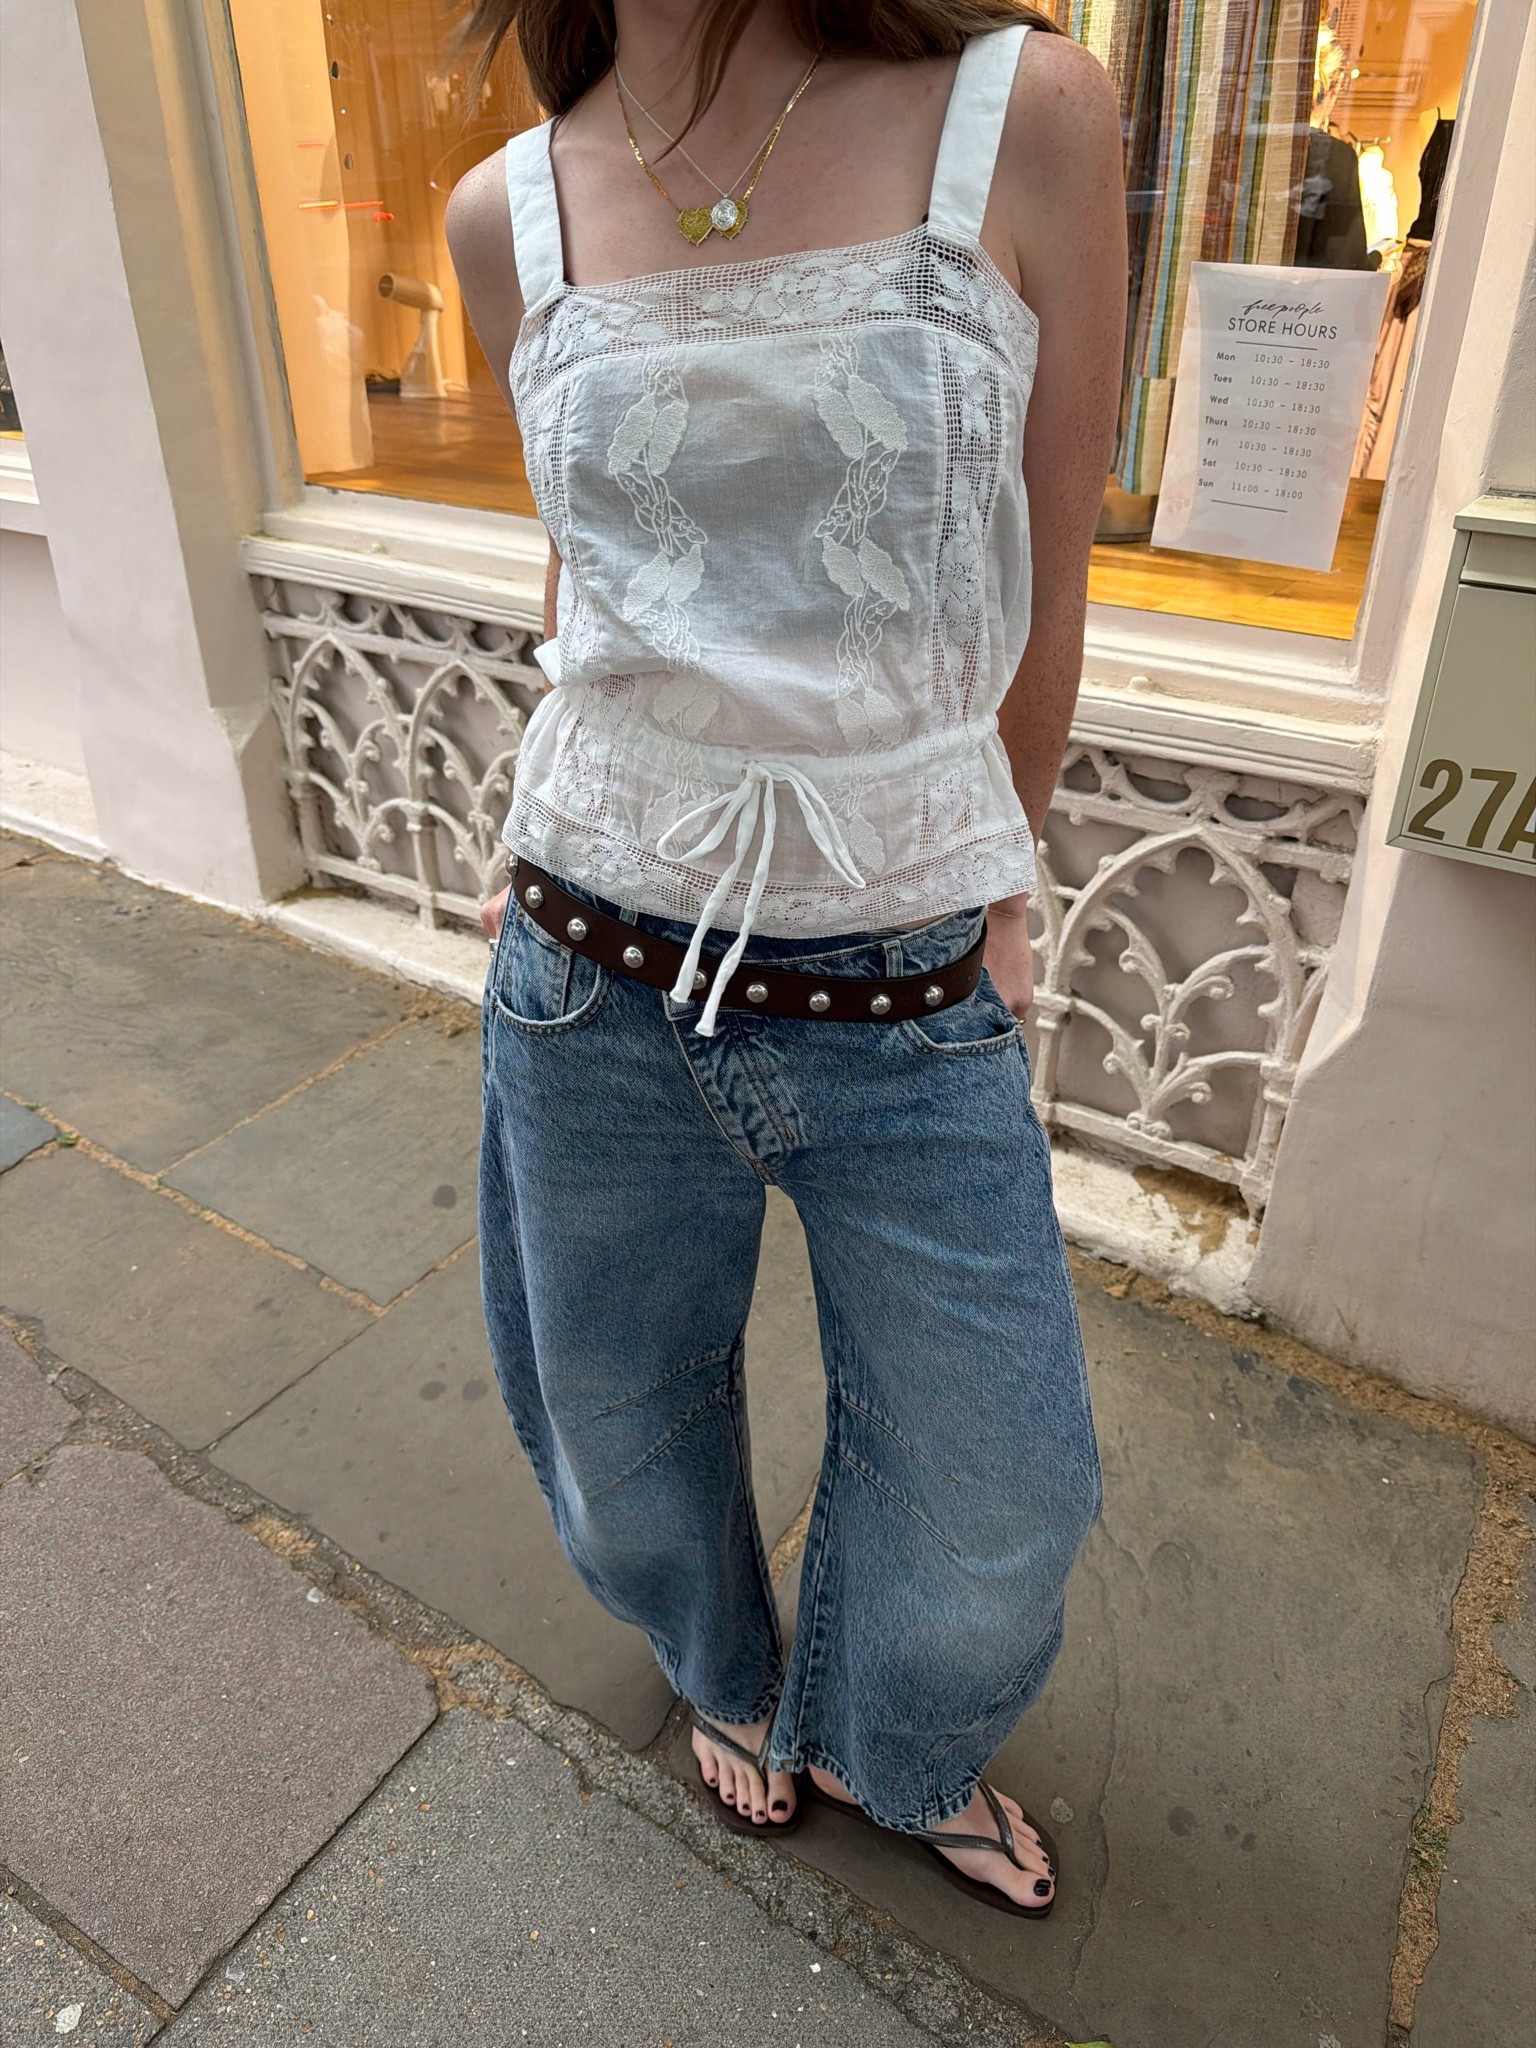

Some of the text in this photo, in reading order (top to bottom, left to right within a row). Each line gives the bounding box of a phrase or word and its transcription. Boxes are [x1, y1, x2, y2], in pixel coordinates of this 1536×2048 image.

[1228, 317, 1337, 339] STORE HOURS
[1216, 352, 1235, 361] Mon
[1254, 354, 1283, 364] 10:30
[1300, 358, 1330, 369] 18:30
[1213, 373, 1232, 383] Tues
[1251, 376, 1279, 387] 10:30
[1296, 381, 1325, 391] 18:30
[1210, 395, 1228, 404] Wed
[1247, 398, 1274, 408] 10:30
[1292, 403, 1320, 414] 18:30
[1205, 416, 1228, 426] Thurs
[1243, 419, 1270, 430] 10:30
[1288, 425, 1316, 436] 18:30
[1207, 438, 1218, 446] Fri
[1239, 441, 1266, 451] 10:30
[1284, 447, 1312, 457] 18:30
[1202, 458, 1216, 467] Sat
[1235, 462, 1262, 472] 10:30
[1279, 468, 1307, 478] 18:30
[1198, 478, 1214, 487] Sun
[1232, 482, 1258, 493] 11:00
[1275, 489, 1303, 499] 18:00
